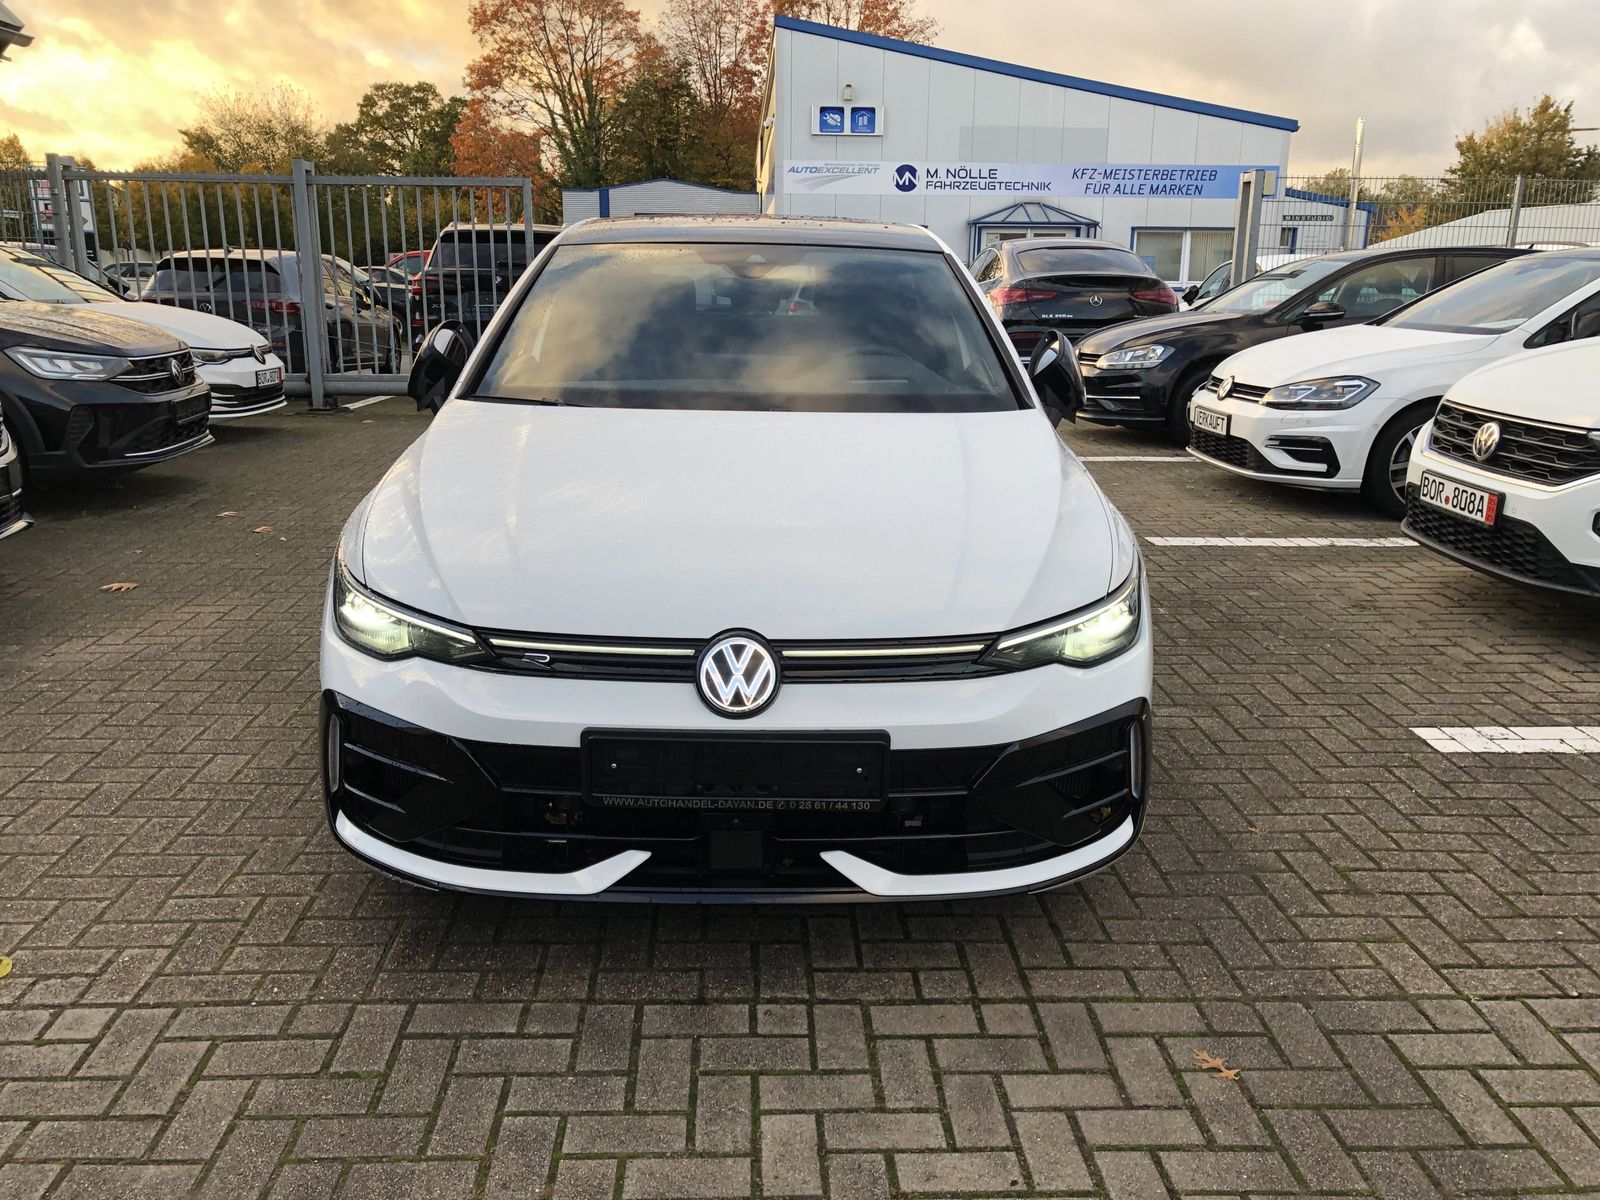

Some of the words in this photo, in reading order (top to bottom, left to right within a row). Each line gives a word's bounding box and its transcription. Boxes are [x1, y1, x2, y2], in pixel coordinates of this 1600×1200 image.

[788, 166, 880, 174] AUTOEXCELLENT
[926, 168, 941, 179] M.
[946, 165, 998, 179] NÖLLE
[1072, 168, 1218, 181] KFZ-MEISTERBETRIEB
[926, 181, 1052, 191] FAHRZEUGTECHNIK
[1085, 181, 1111, 194] FÜR
[1113, 183, 1147, 195] ALLE
[1148, 184, 1203, 196] MARKEN
[1196, 409, 1226, 432] VERKAUFT
[1421, 476, 1445, 504] BOR
[603, 797, 773, 809] WWW.AUTOHANDEL-DAYAN.DE
[836, 801, 848, 810] 44
[851, 801, 870, 810] 130
